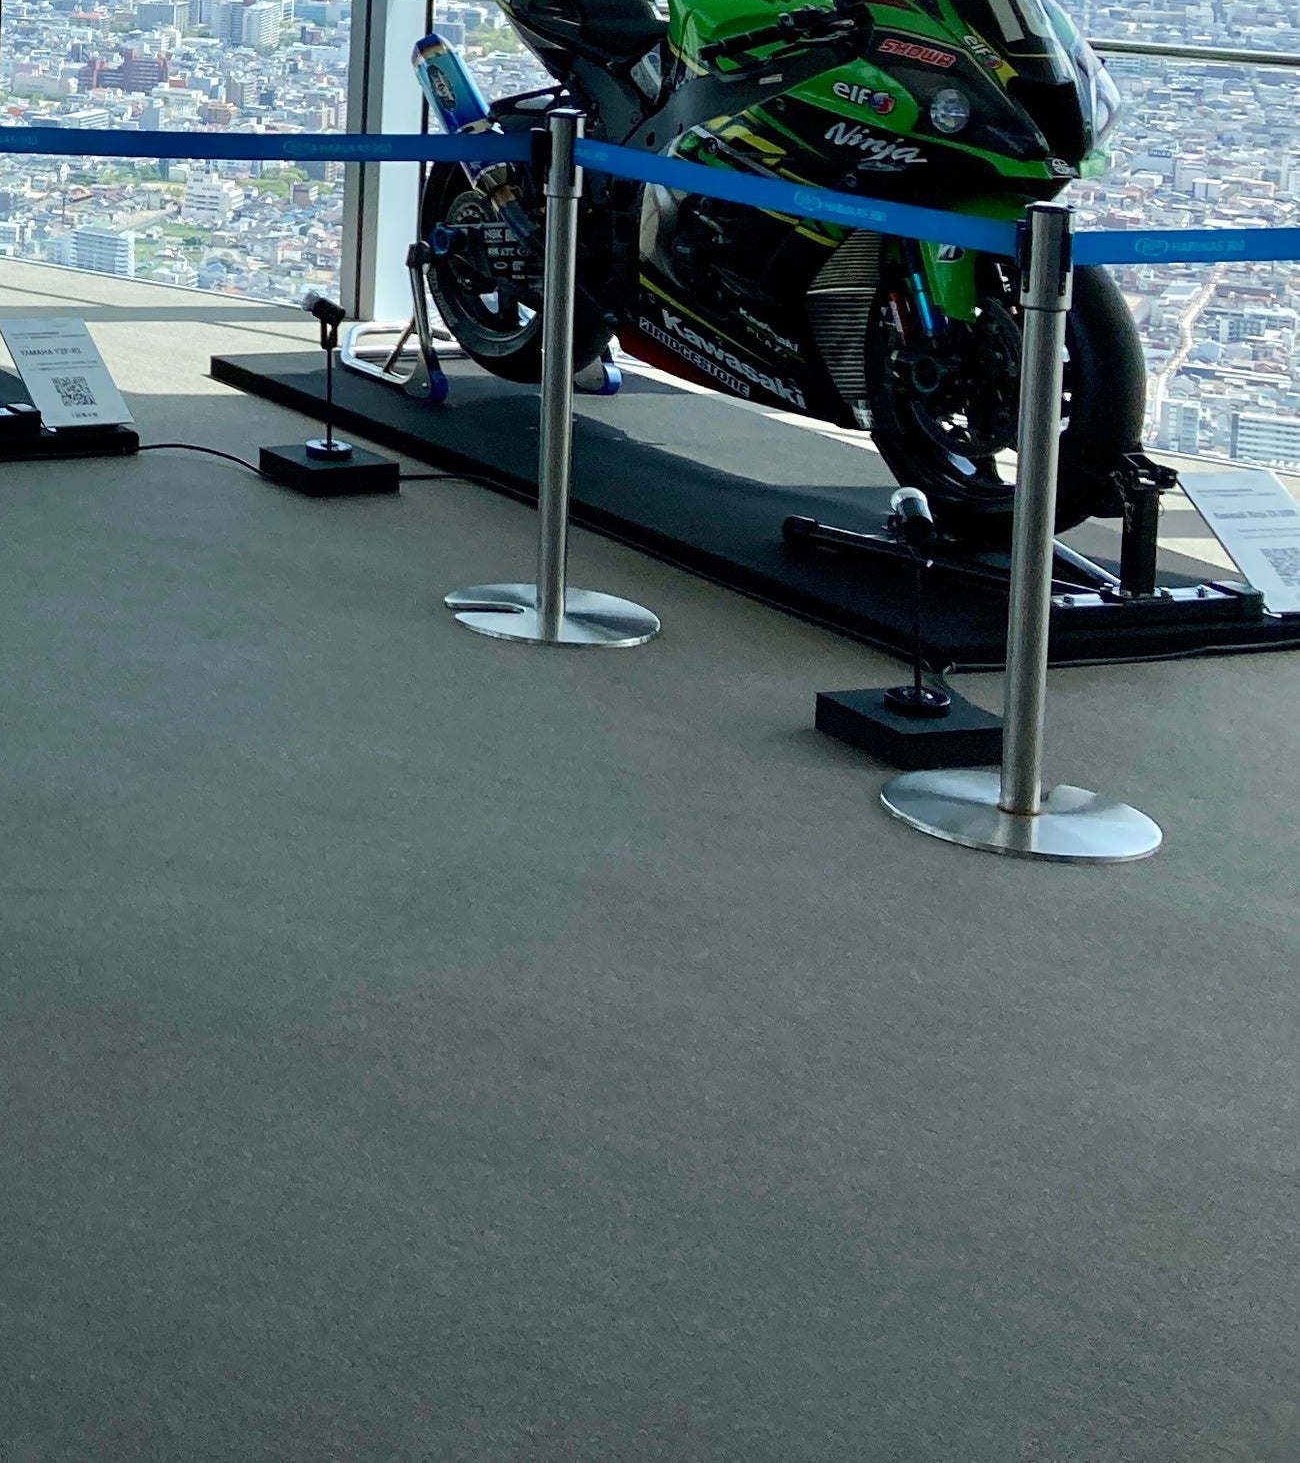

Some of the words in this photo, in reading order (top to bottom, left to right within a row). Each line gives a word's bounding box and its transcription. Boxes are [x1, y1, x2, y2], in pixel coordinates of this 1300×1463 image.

[878, 39, 956, 68] SHOWA
[832, 81, 871, 106] elf
[824, 122, 928, 165] Ninja
[639, 316, 750, 398] BRIDGESTONE
[662, 309, 807, 409] Kawasaki
